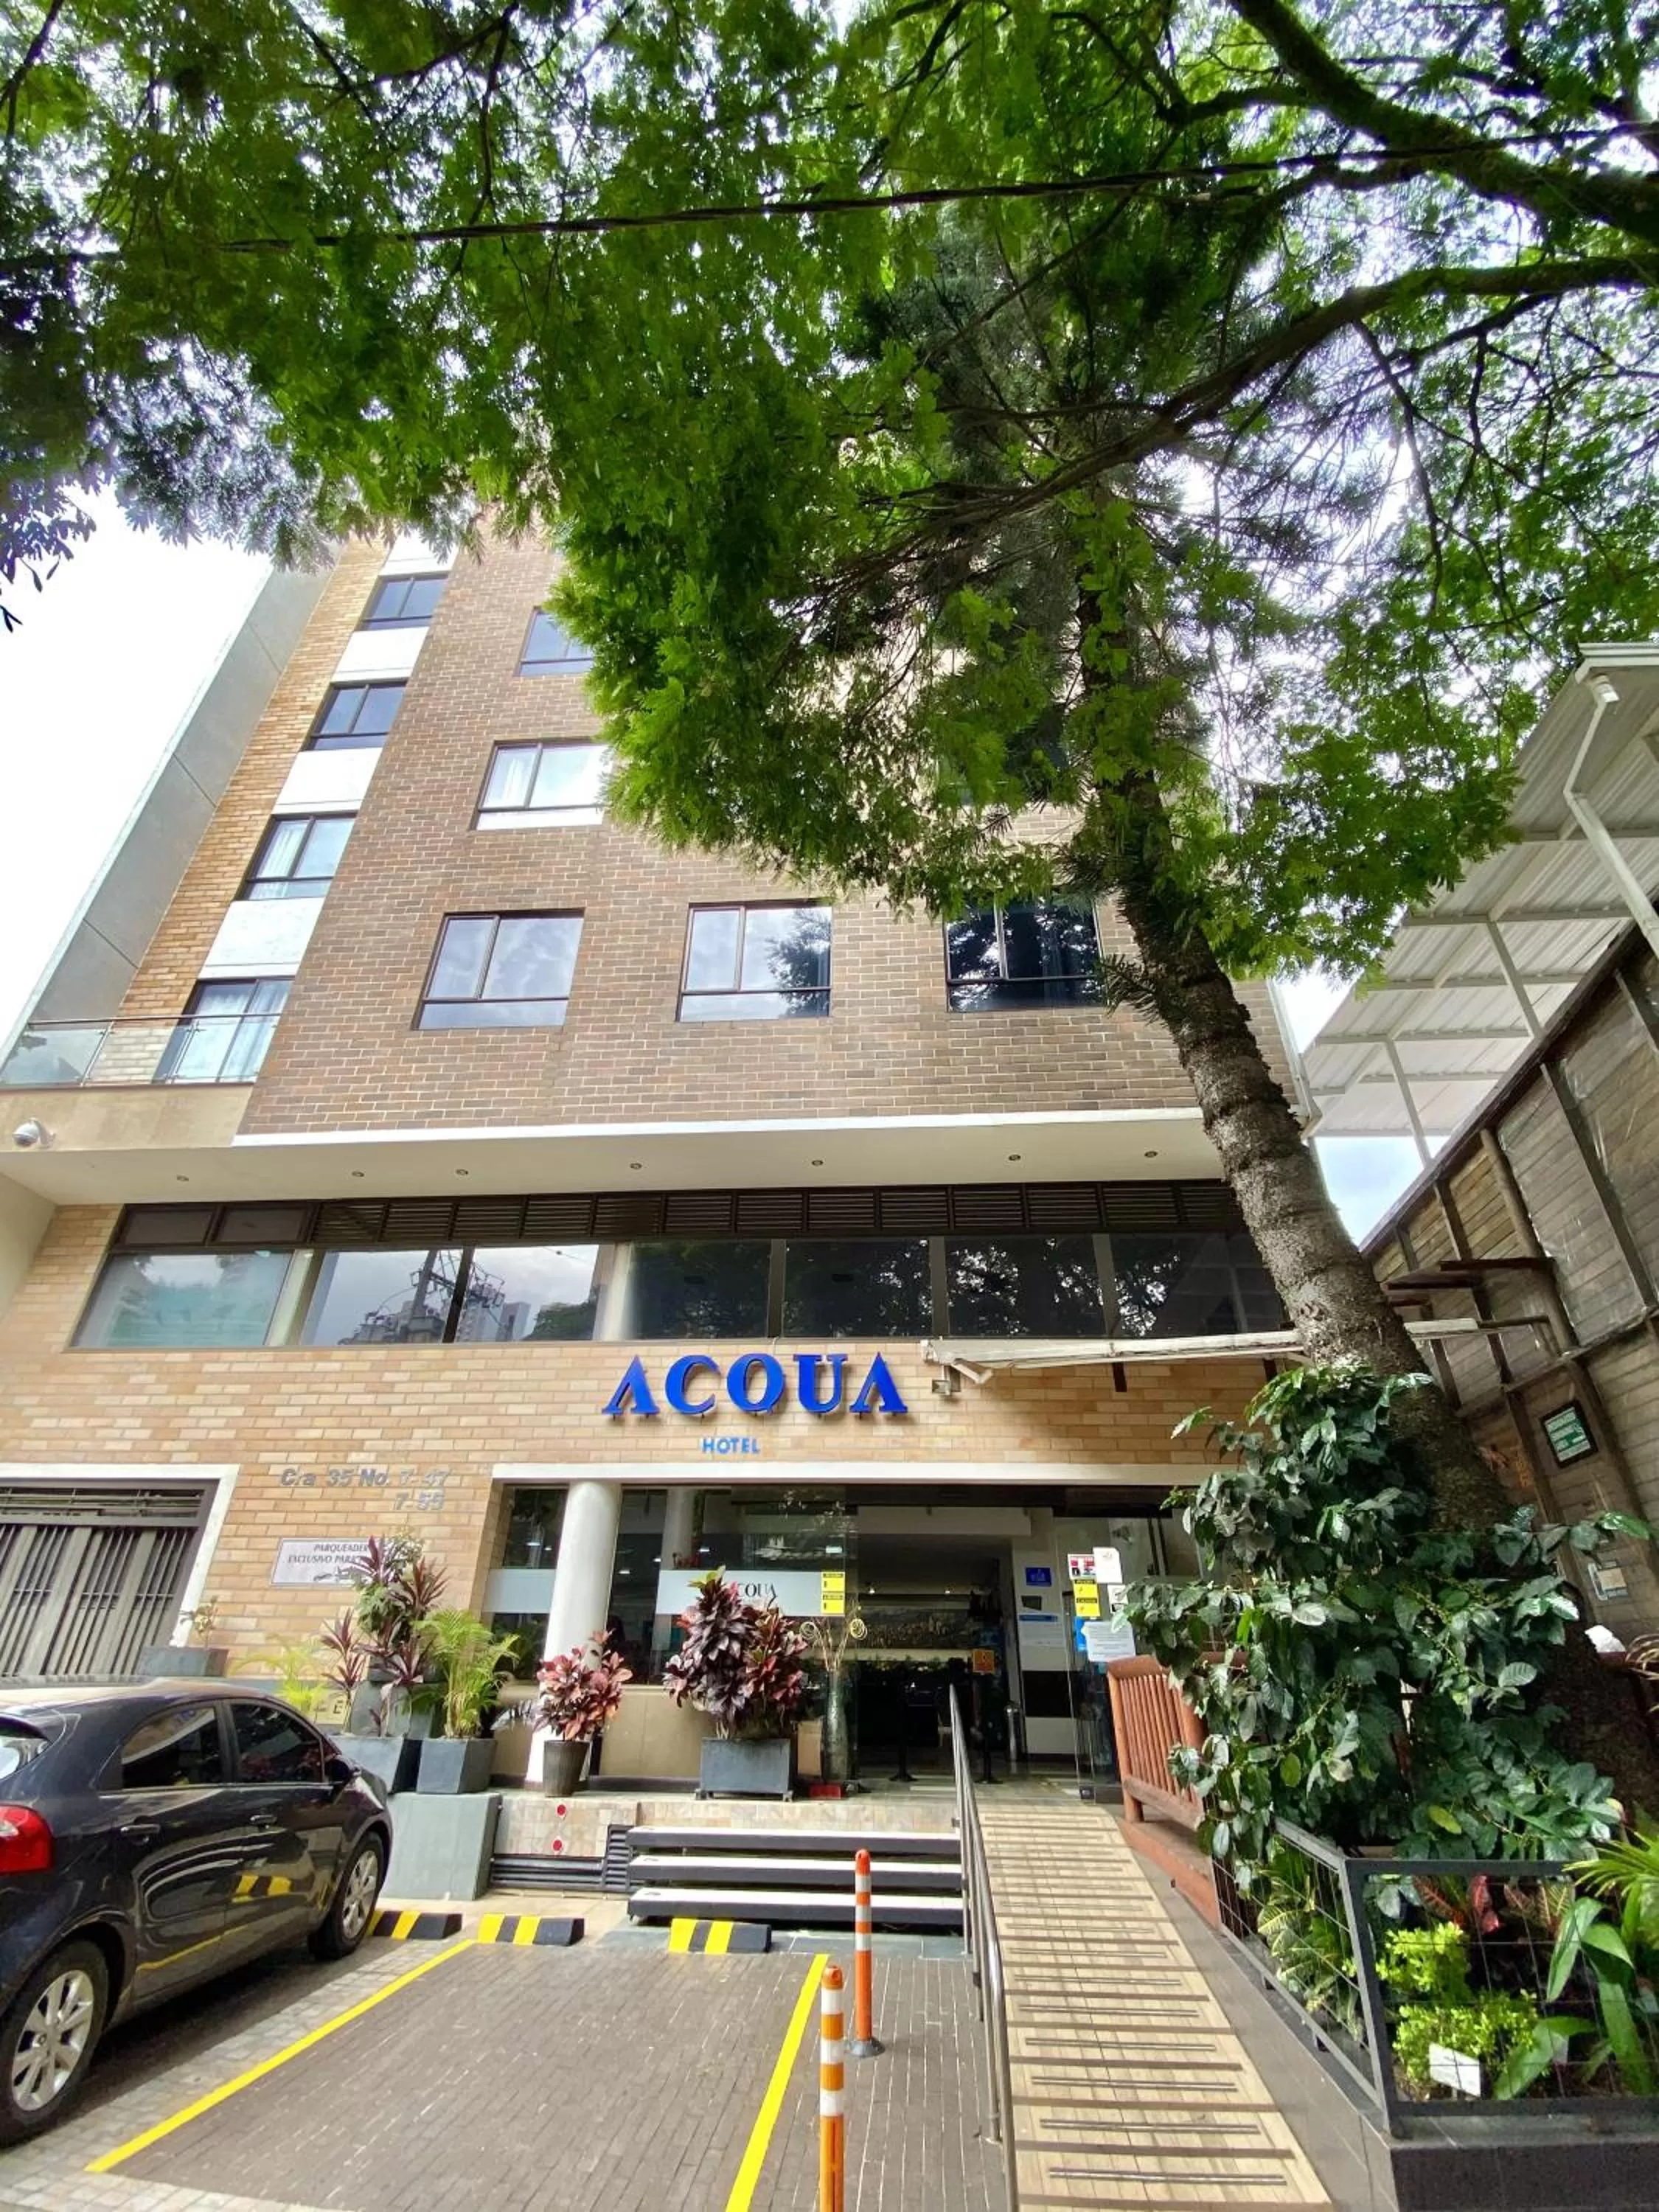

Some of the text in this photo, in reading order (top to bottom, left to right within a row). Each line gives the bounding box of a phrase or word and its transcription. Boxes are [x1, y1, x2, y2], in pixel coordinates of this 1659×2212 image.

[601, 1352, 908, 1415] ACQUA
[702, 1438, 760, 1453] HOTEL
[327, 1469, 354, 1486] 35
[314, 1543, 369, 1552] PARQUEADER
